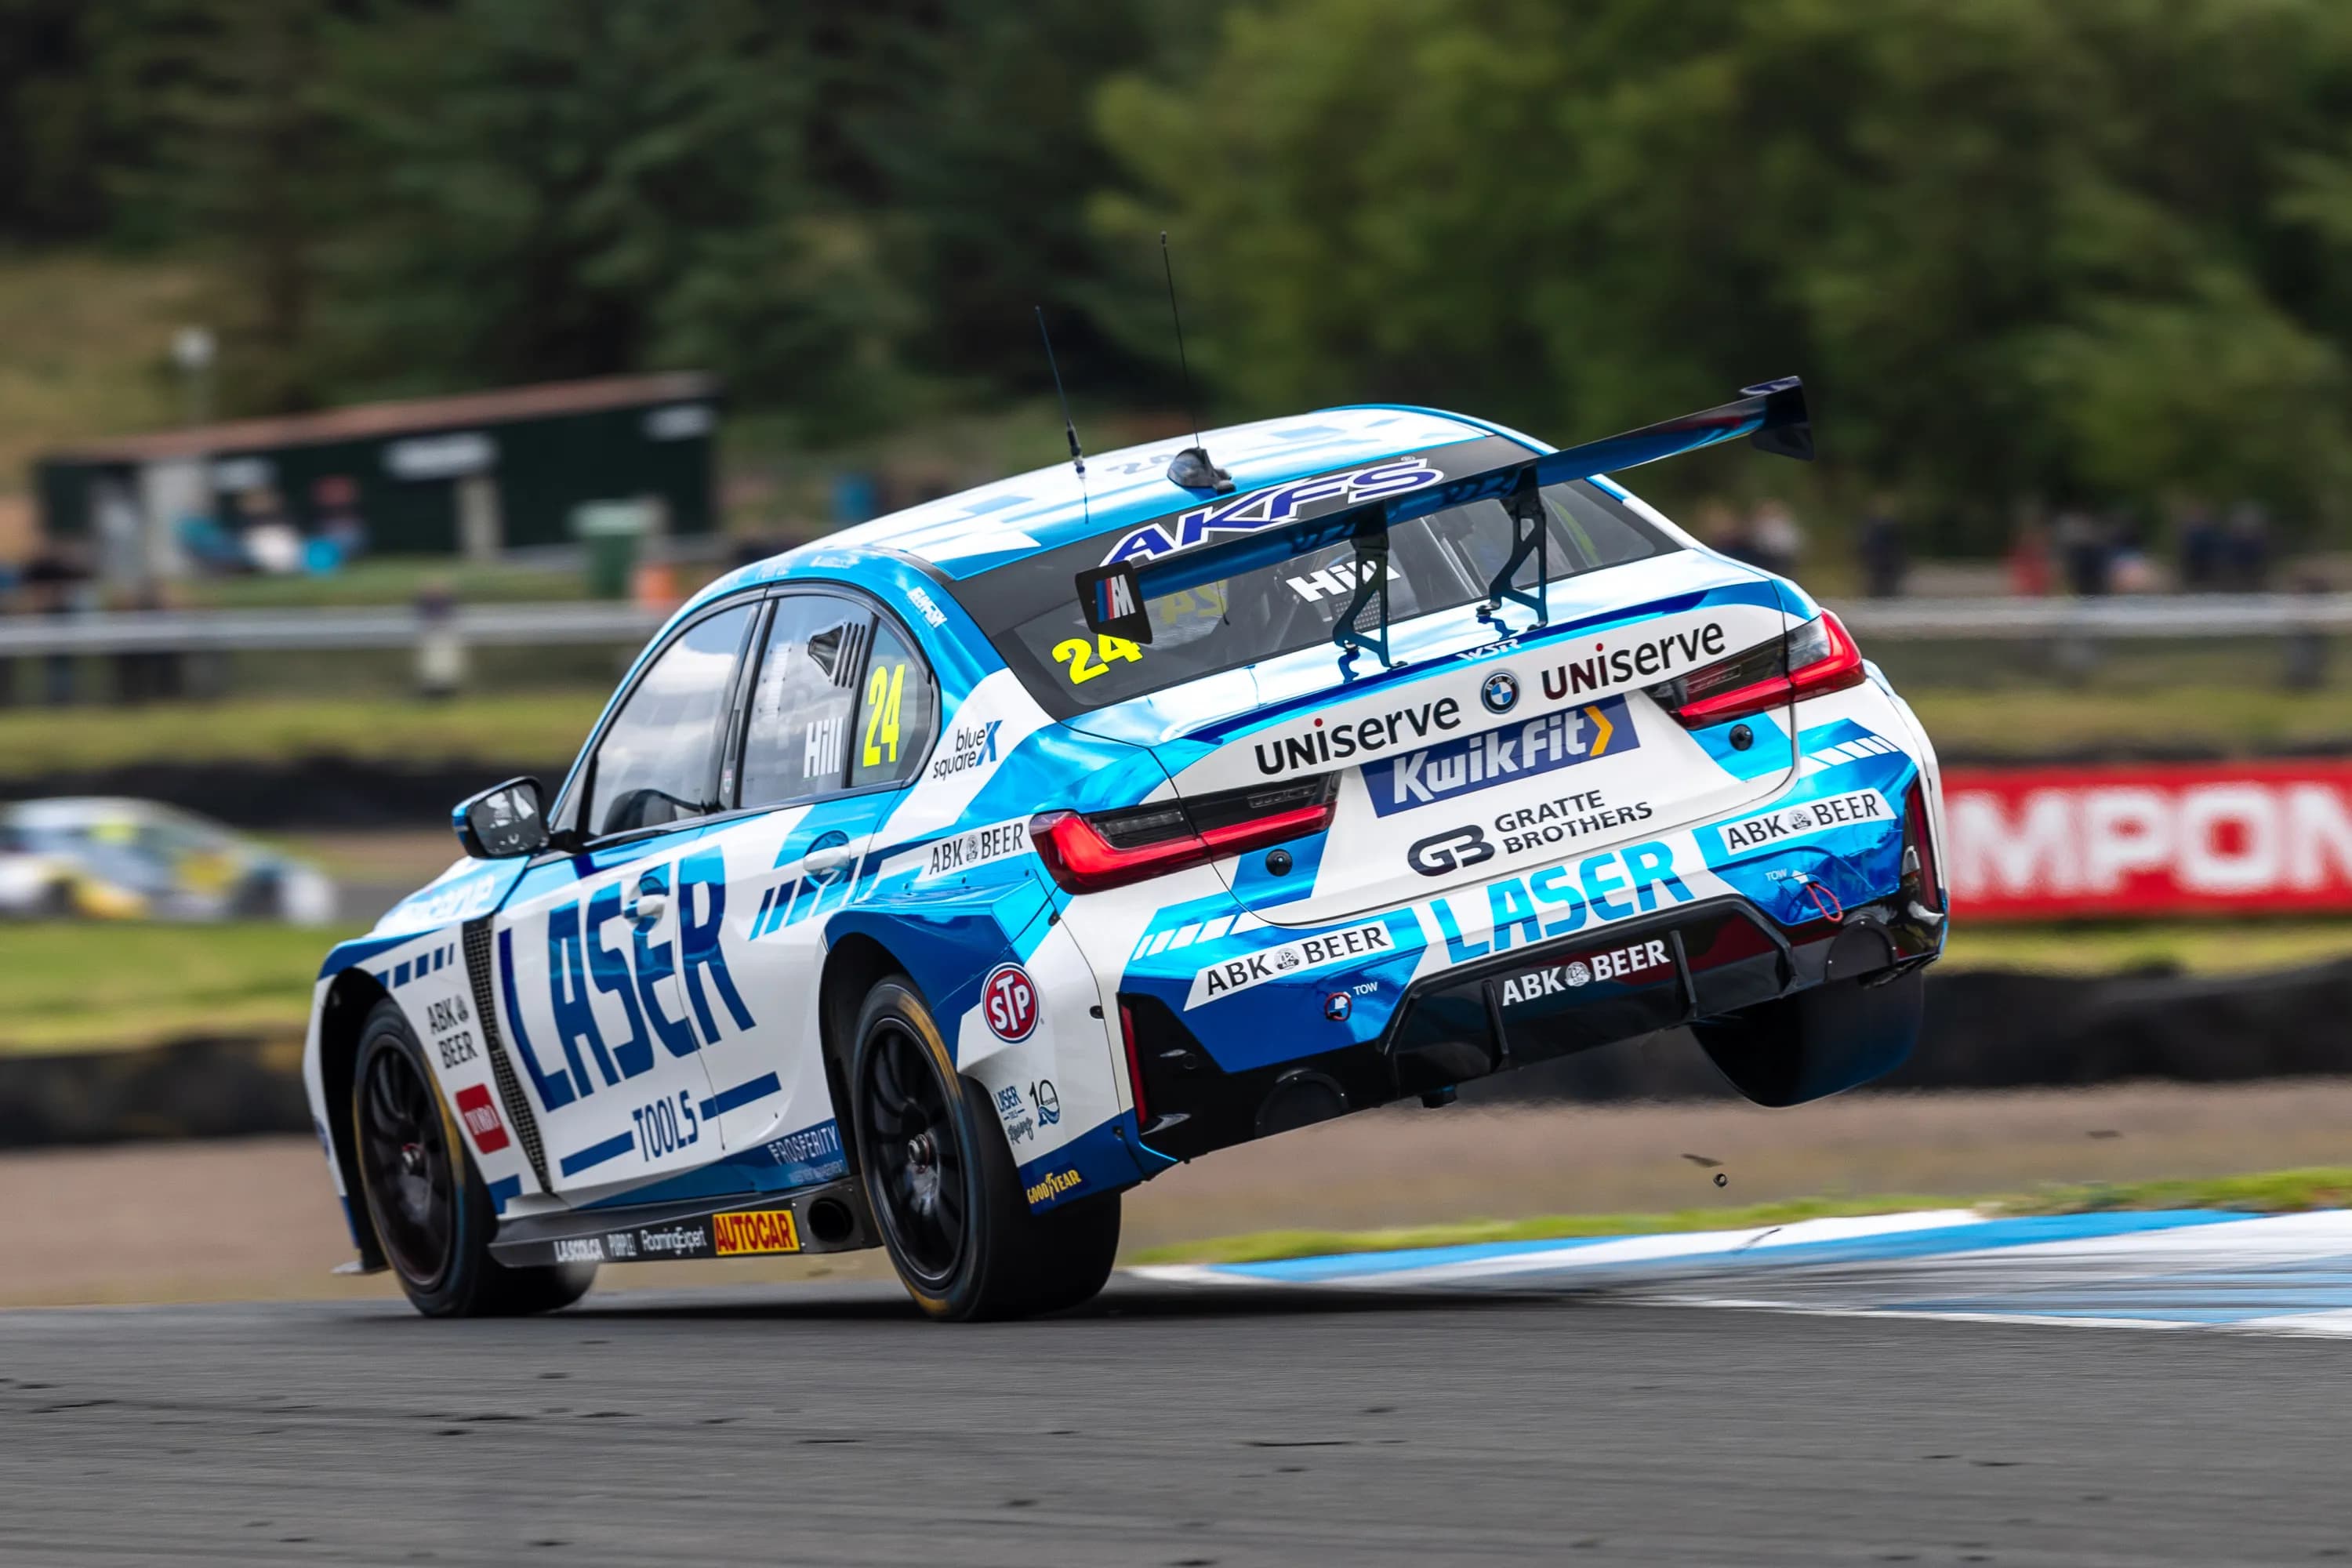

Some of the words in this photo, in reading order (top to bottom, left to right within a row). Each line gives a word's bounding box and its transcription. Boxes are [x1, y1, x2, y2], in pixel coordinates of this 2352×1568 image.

[1098, 458, 1446, 568] AKFS
[1051, 633, 1143, 685] 24
[1455, 639, 1521, 662] WSR
[863, 664, 906, 768] 24
[956, 727, 985, 753] blue
[803, 717, 844, 779] Hill
[933, 750, 977, 781] square
[1494, 789, 1606, 833] GRATTE
[1503, 802, 1653, 854] BROTHERS
[1727, 815, 1788, 849] ABK
[1812, 793, 1880, 826] BEER
[929, 838, 963, 875] ABK
[981, 822, 1023, 859] BEER
[1407, 824, 1495, 877] GB
[1765, 868, 1787, 881] TOW
[1429, 840, 1696, 964] LASER
[498, 844, 757, 1112] LASER
[1207, 954, 1273, 996] ABK
[1302, 927, 1388, 965] BEER
[1502, 966, 1566, 1007] ABK
[1592, 939, 1671, 982] BEER
[991, 975, 1030, 1032] STP
[1353, 982, 1378, 996] TOW
[427, 997, 458, 1034] ABK
[438, 1031, 478, 1069] BEER
[993, 1085, 1022, 1112] LASER
[633, 1089, 698, 1162] TOOLS
[714, 1213, 794, 1251] AUTOCAR
